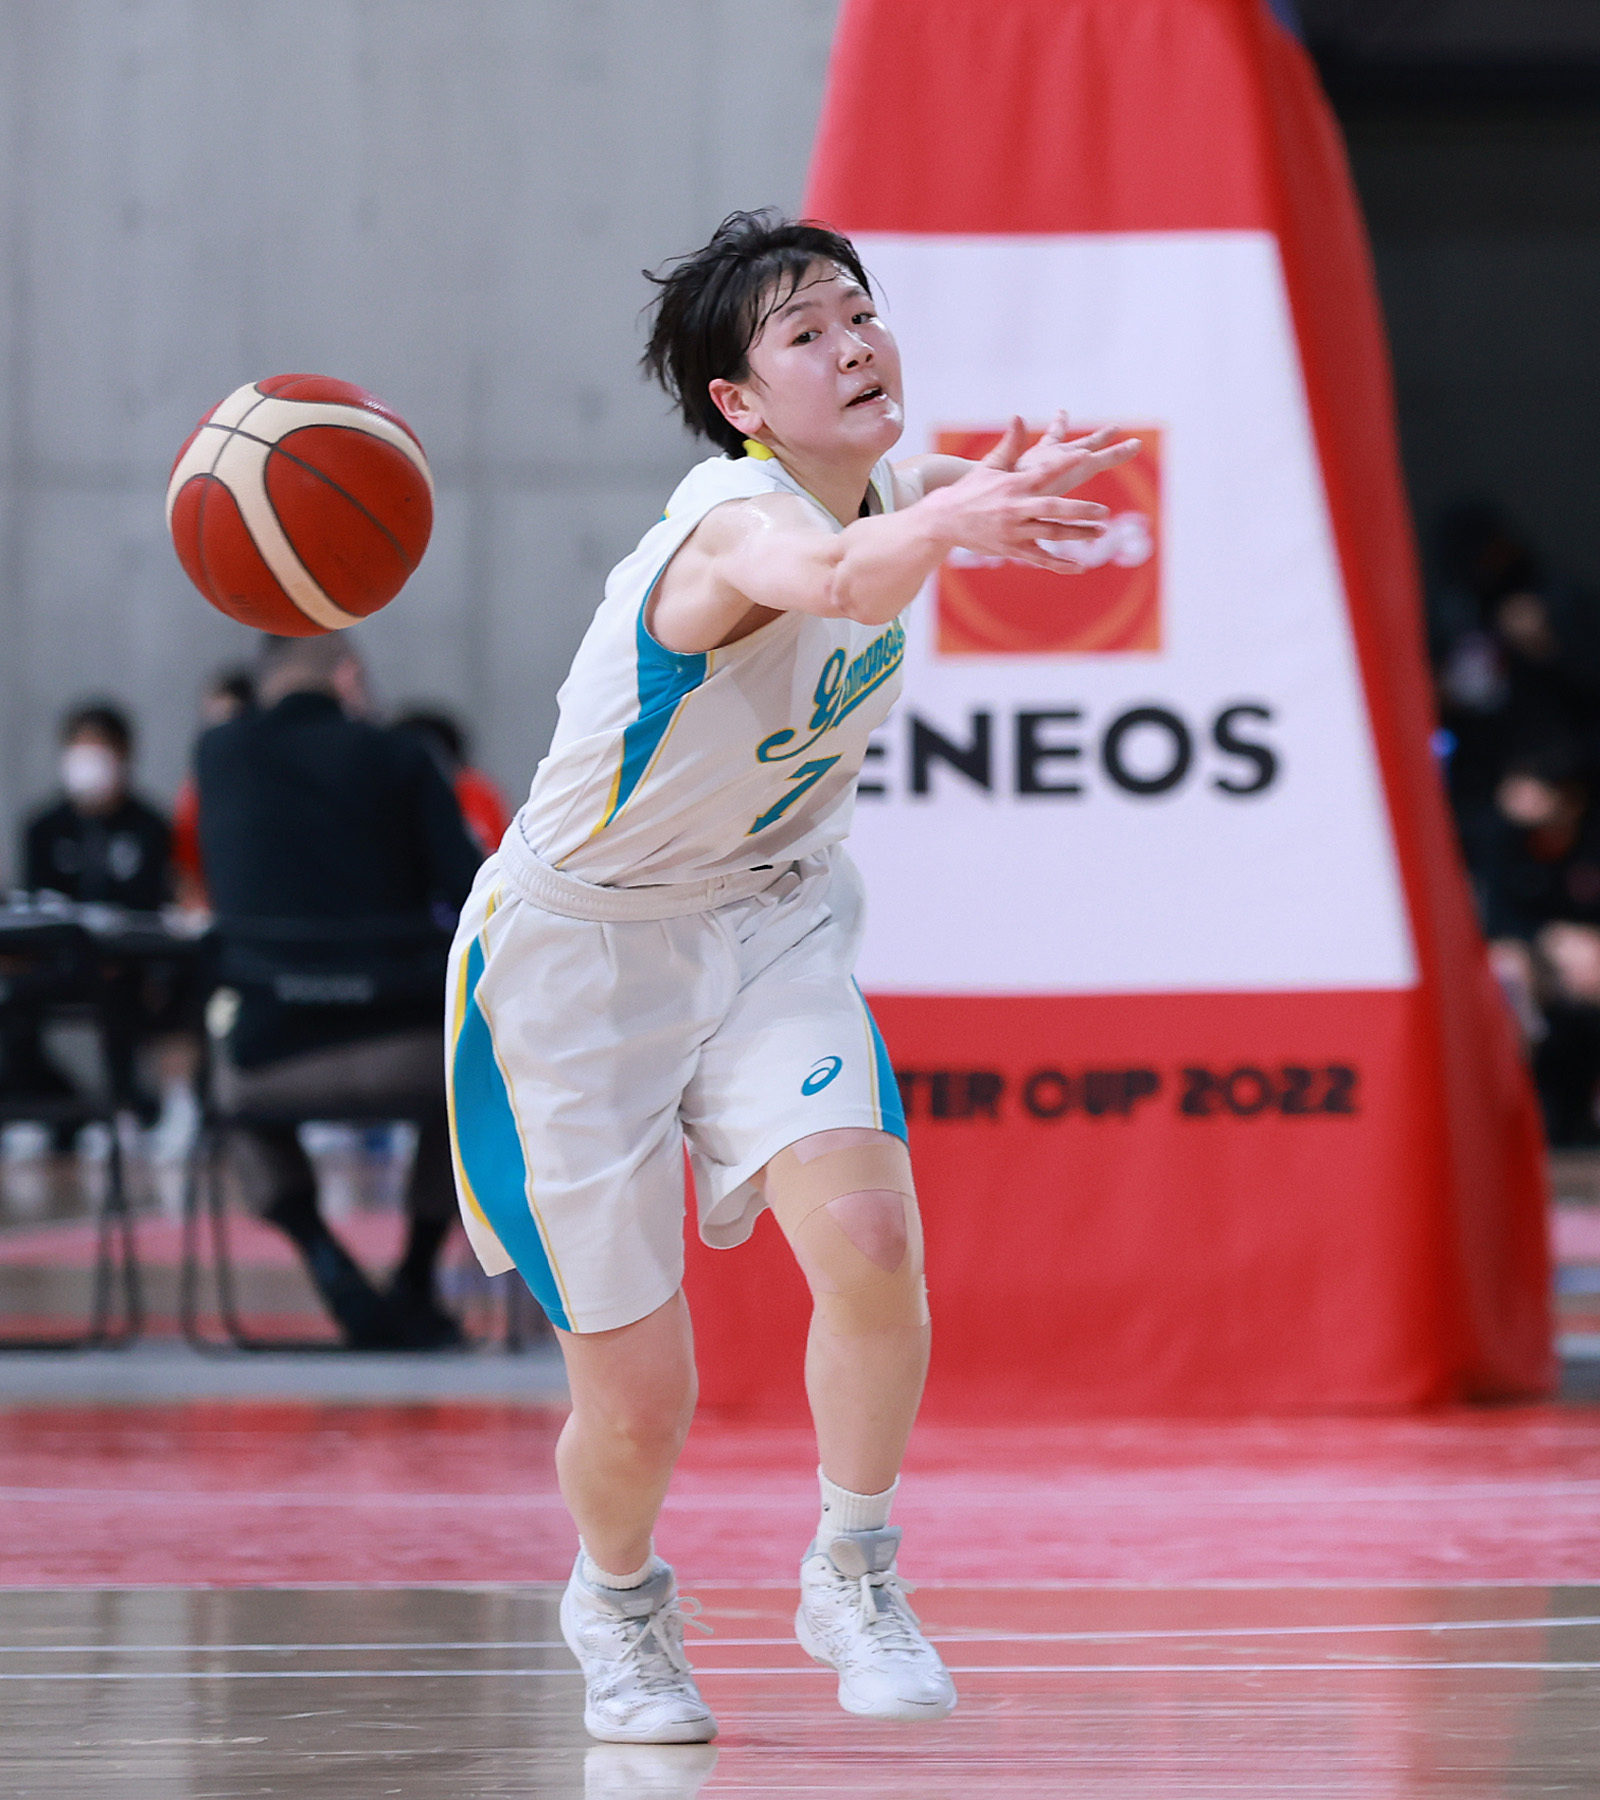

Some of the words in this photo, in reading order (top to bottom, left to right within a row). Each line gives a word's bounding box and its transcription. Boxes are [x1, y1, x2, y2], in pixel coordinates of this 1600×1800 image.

[744, 753, 843, 836] 7
[1024, 1069, 1159, 1119] CUP
[1181, 1067, 1355, 1116] 2022
